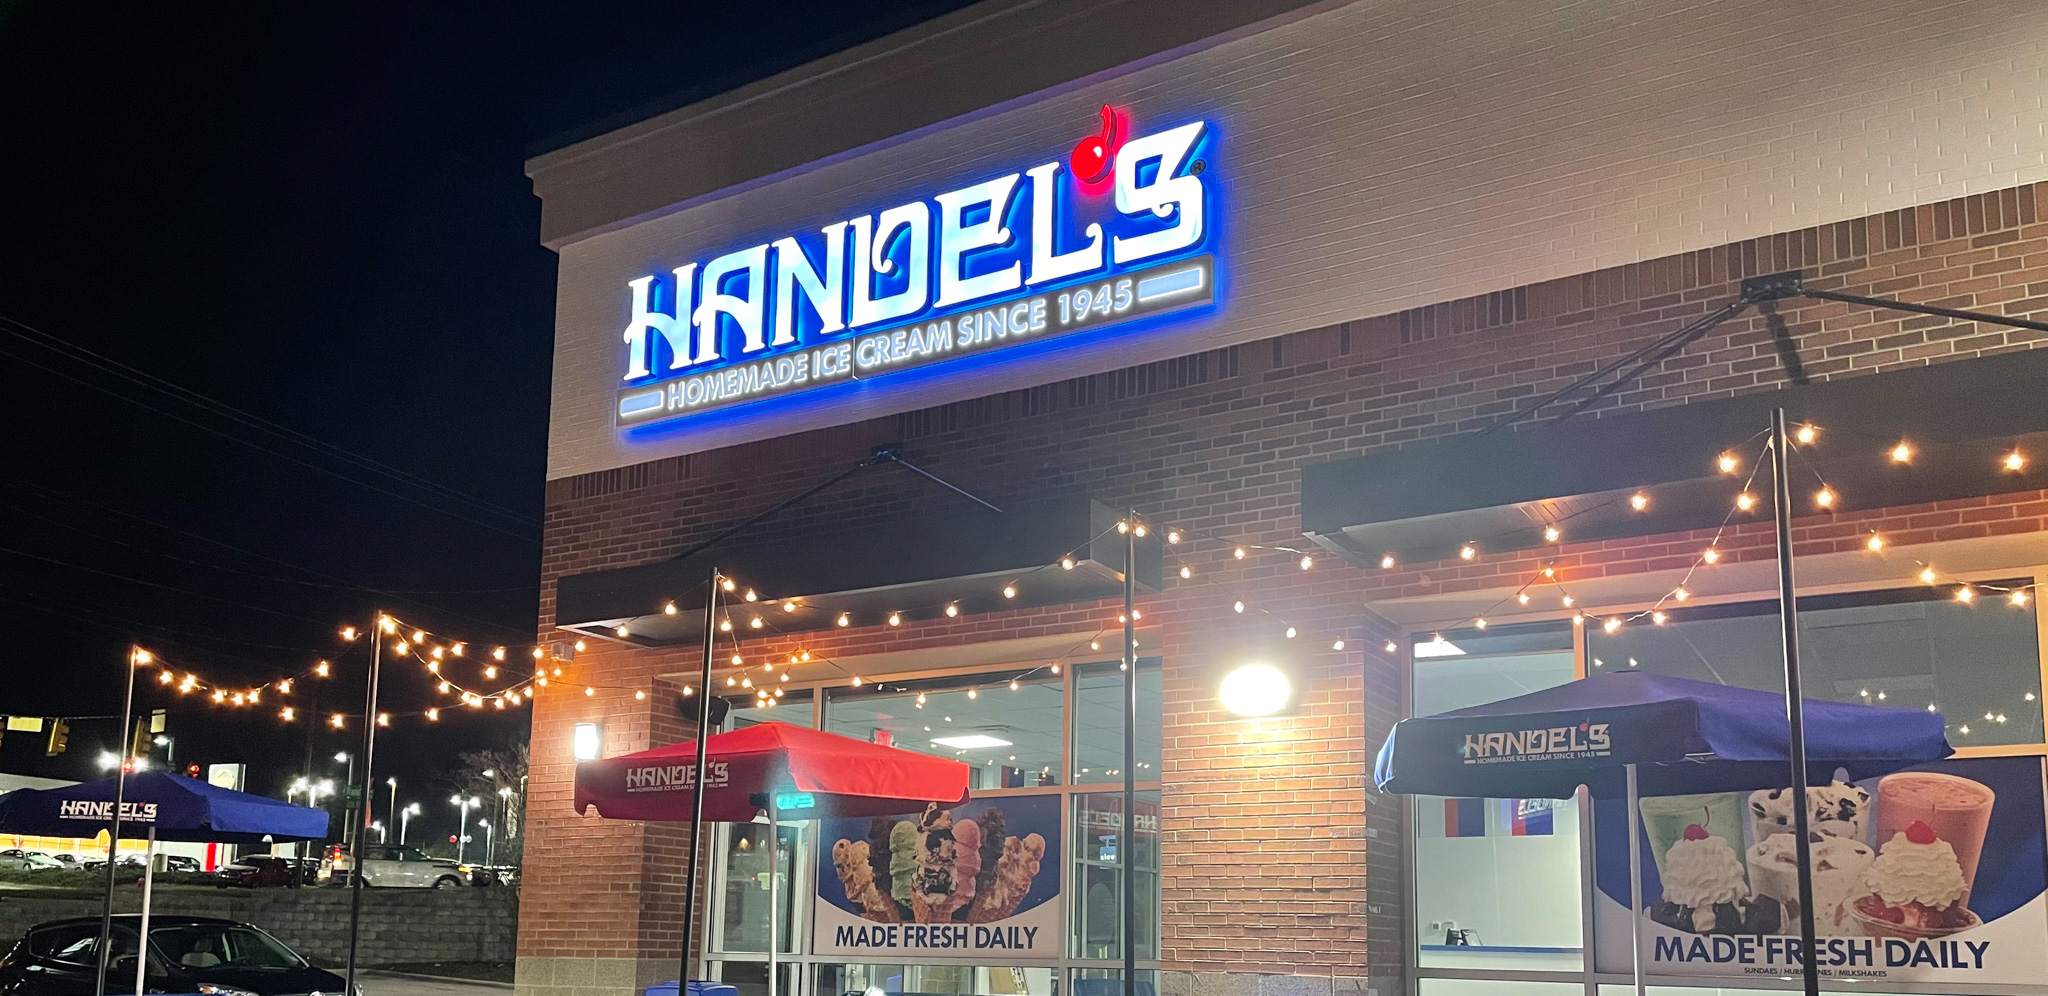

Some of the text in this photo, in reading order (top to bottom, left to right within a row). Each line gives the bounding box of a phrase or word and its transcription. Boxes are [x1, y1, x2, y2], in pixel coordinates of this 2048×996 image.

[622, 104, 1206, 381] HANDEL'S
[667, 279, 1133, 410] HOMEMADE ICE CREAM SINCE 1945
[1463, 718, 1611, 759] HANDEL'S
[1476, 756, 1516, 765] HOMEMADE
[1528, 753, 1552, 761] CREAM
[1553, 751, 1575, 760] SINCE
[1577, 751, 1595, 759] 1945
[835, 925, 1039, 949] MADE FRESH DAILY
[1654, 936, 1991, 969] MADE FRESH DAILY
[1784, 968, 1832, 976] HURRNES
